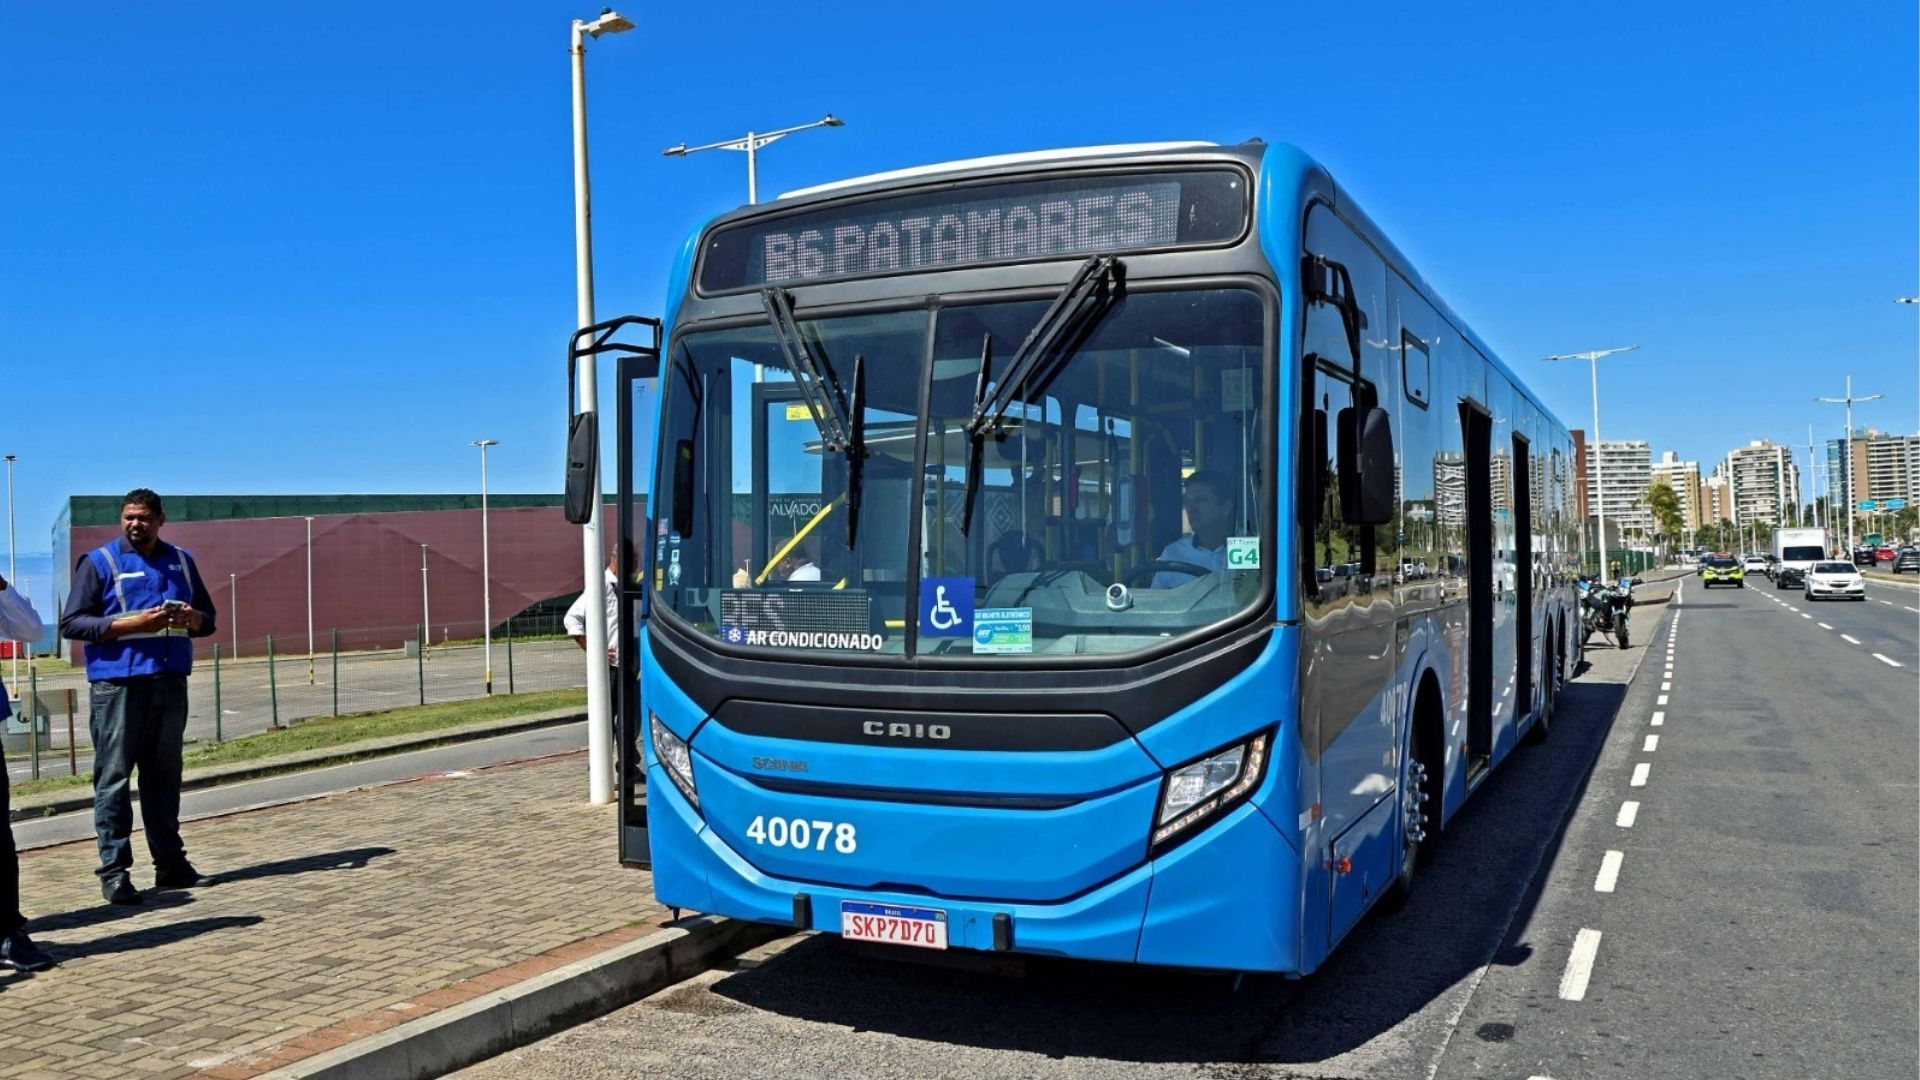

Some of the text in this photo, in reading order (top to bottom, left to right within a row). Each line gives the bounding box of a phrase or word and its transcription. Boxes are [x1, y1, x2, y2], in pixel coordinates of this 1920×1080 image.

[764, 191, 1153, 282] B6 PATAMARES
[1228, 548, 1258, 565] G4
[746, 630, 883, 650] AR CONDICIONADO
[863, 720, 951, 739] CAIO
[752, 756, 809, 772] SCANIA
[746, 815, 857, 854] 40078
[852, 915, 935, 944] SKP7D70
